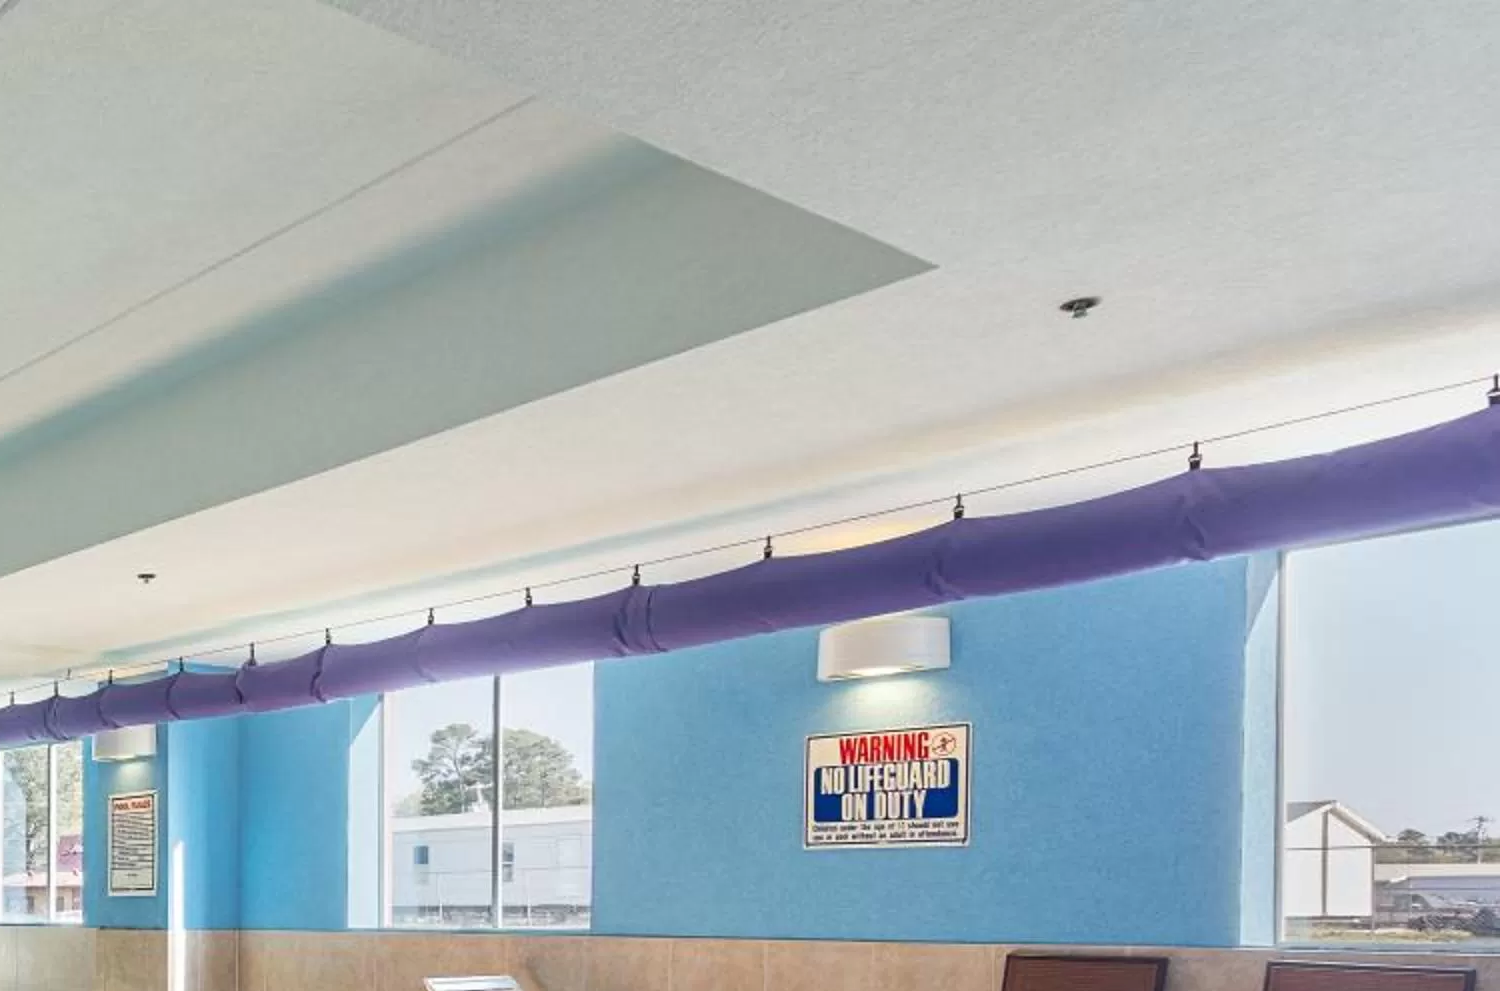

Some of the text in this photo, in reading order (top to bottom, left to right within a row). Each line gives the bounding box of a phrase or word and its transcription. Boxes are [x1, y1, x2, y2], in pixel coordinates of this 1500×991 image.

[839, 731, 929, 764] WARNING
[820, 759, 951, 795] NO LIFEGUARD
[841, 789, 927, 821] ON DUTY
